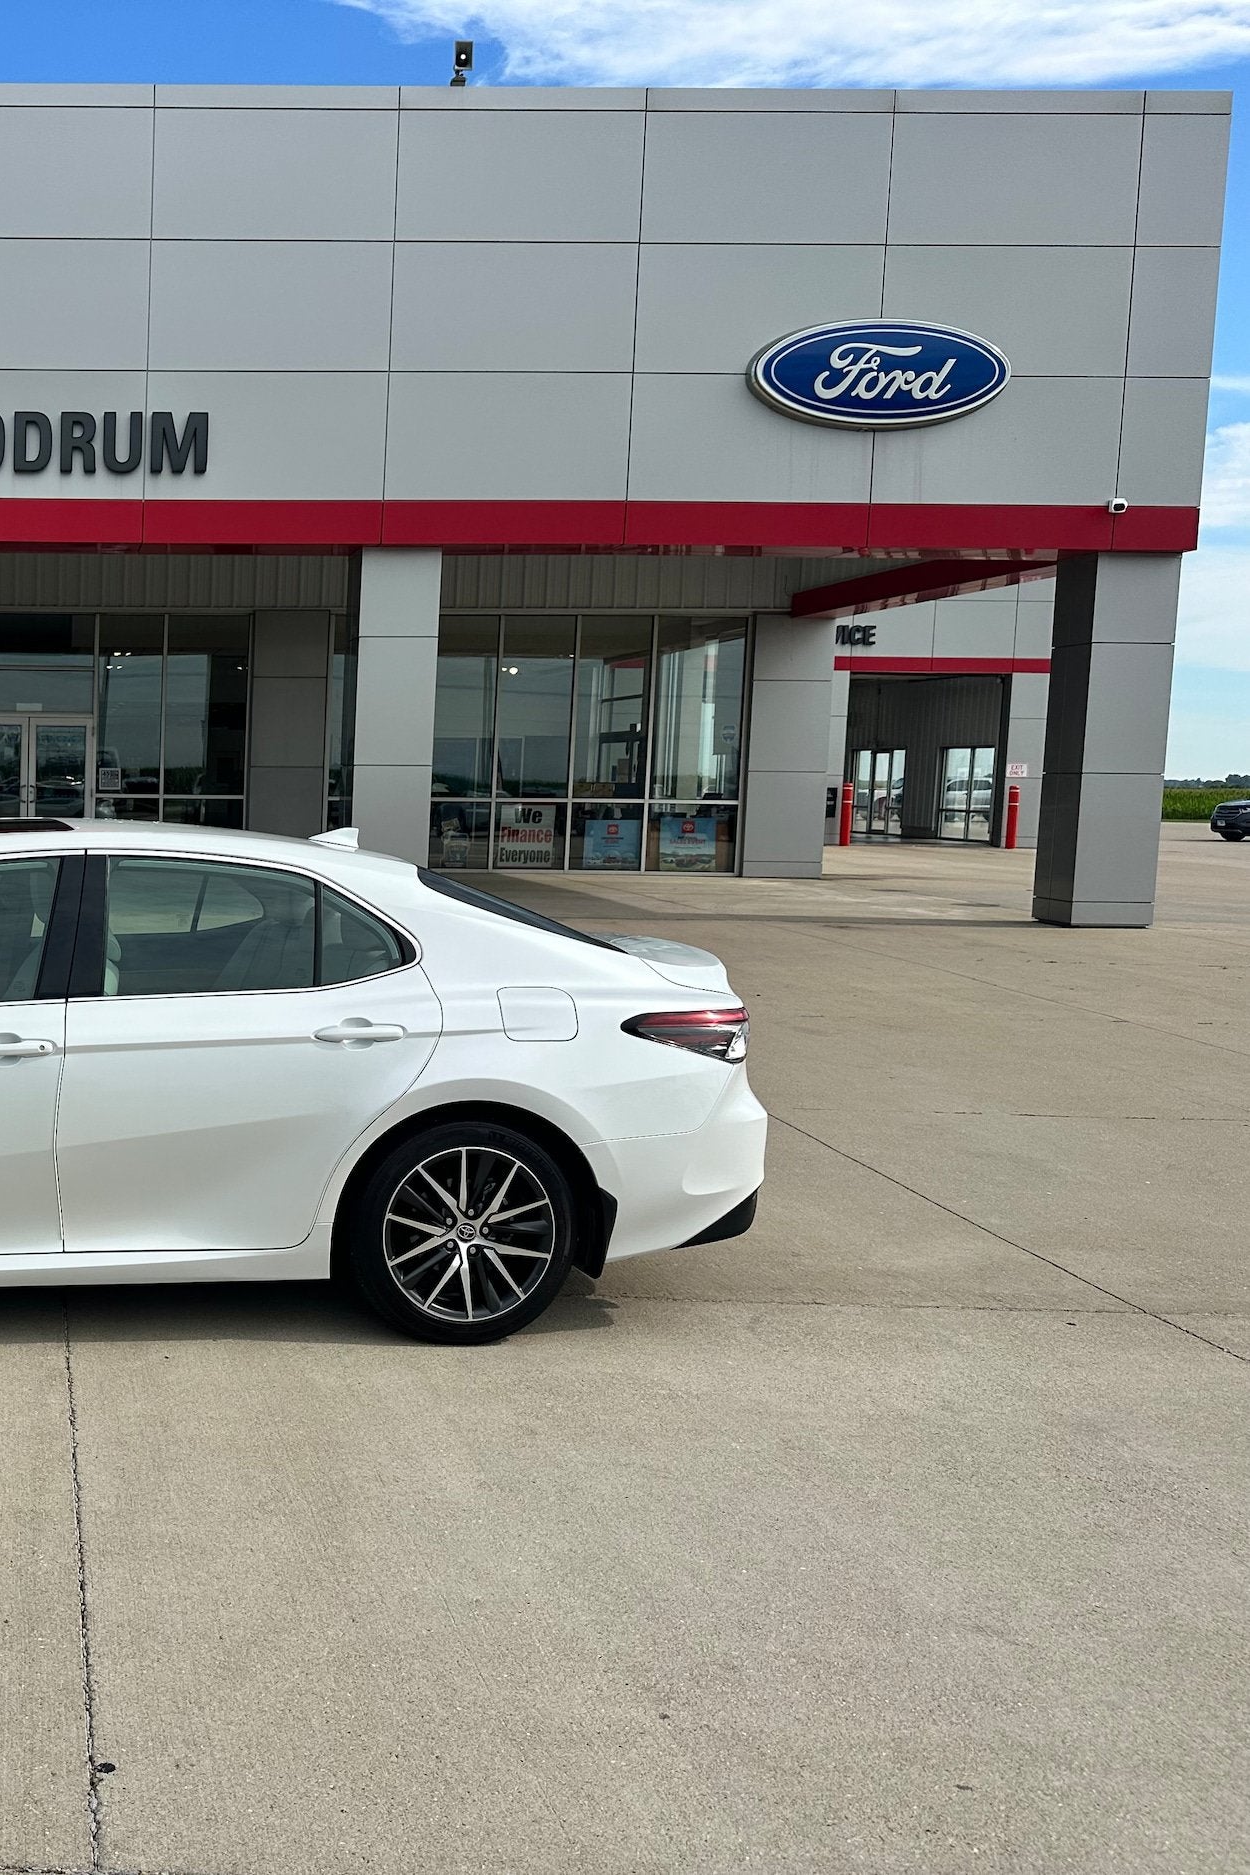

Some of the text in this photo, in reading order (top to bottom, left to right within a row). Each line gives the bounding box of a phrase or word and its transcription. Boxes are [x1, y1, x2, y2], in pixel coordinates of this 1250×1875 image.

[814, 343, 957, 400] Ford
[514, 807, 542, 824] We
[501, 826, 552, 843] Finance
[500, 847, 550, 864] Everyone
